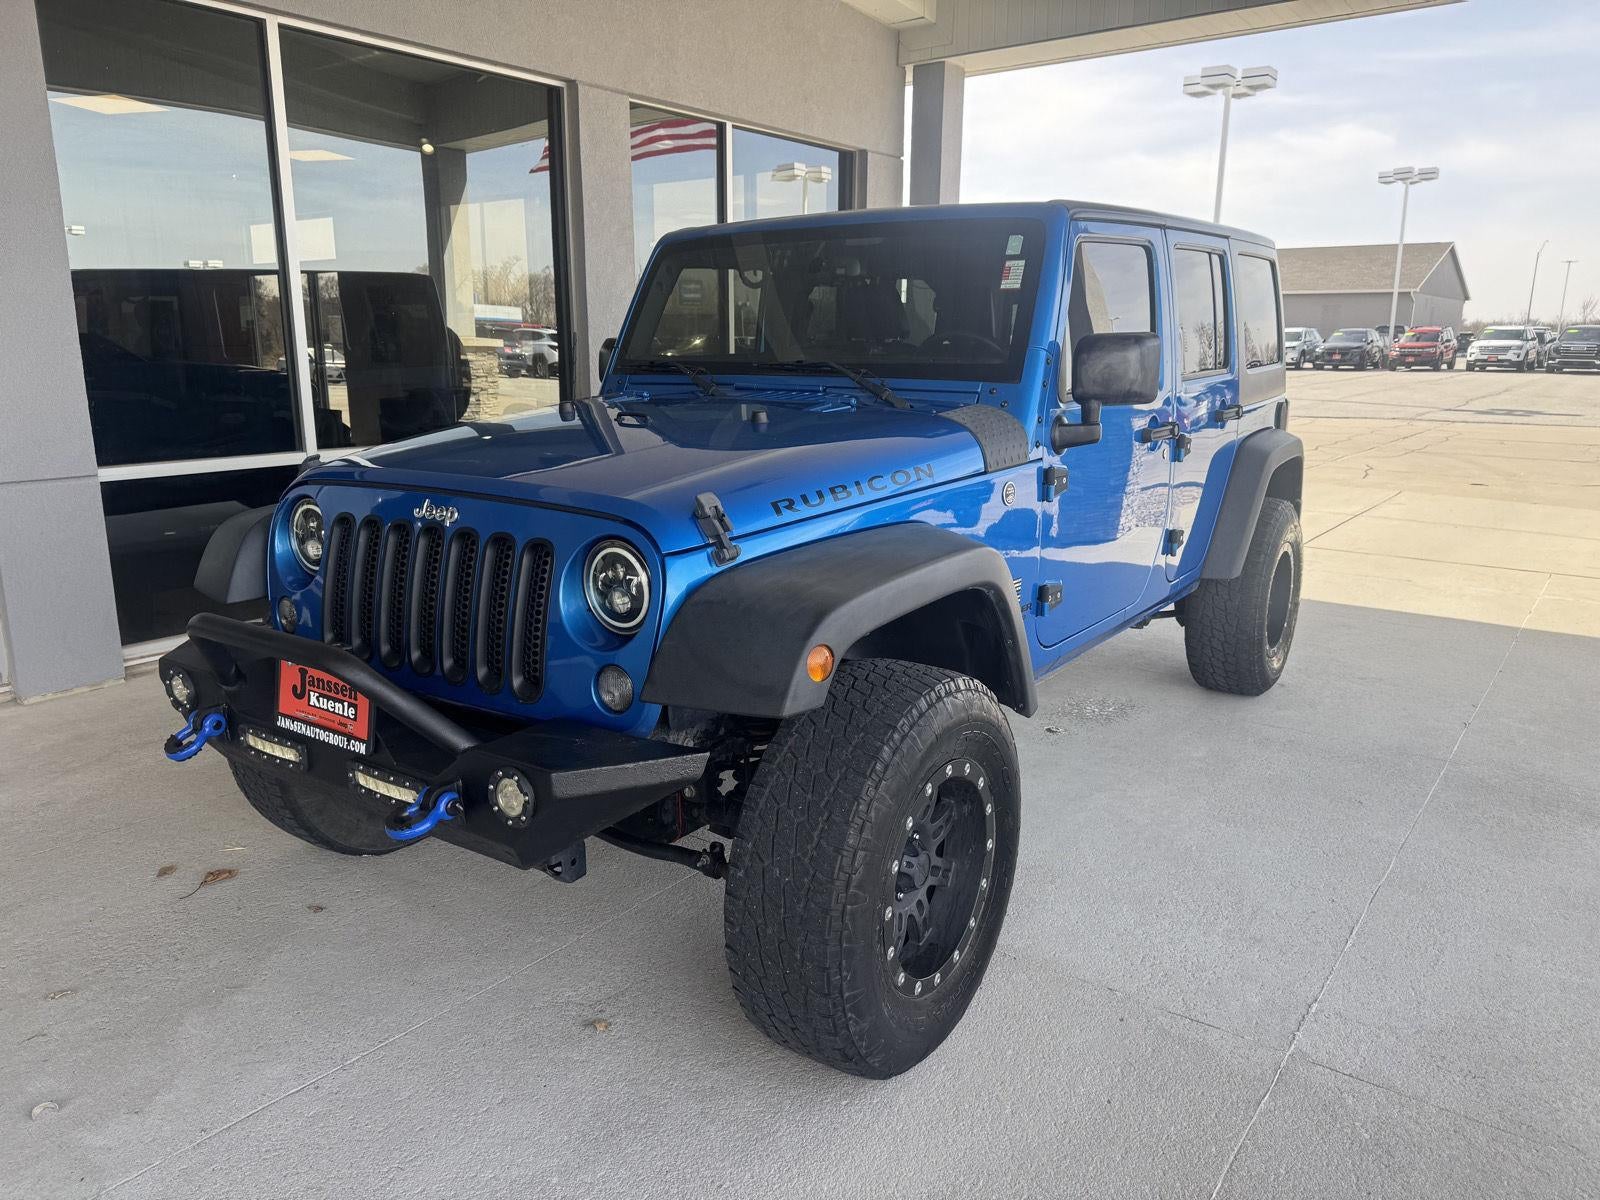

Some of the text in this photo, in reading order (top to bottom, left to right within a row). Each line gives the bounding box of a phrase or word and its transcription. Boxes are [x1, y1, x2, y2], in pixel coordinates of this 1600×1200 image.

[770, 463, 935, 517] RUBICON
[413, 498, 459, 527] Jeep
[291, 667, 359, 702] Janssen
[309, 691, 356, 719] Kuenle
